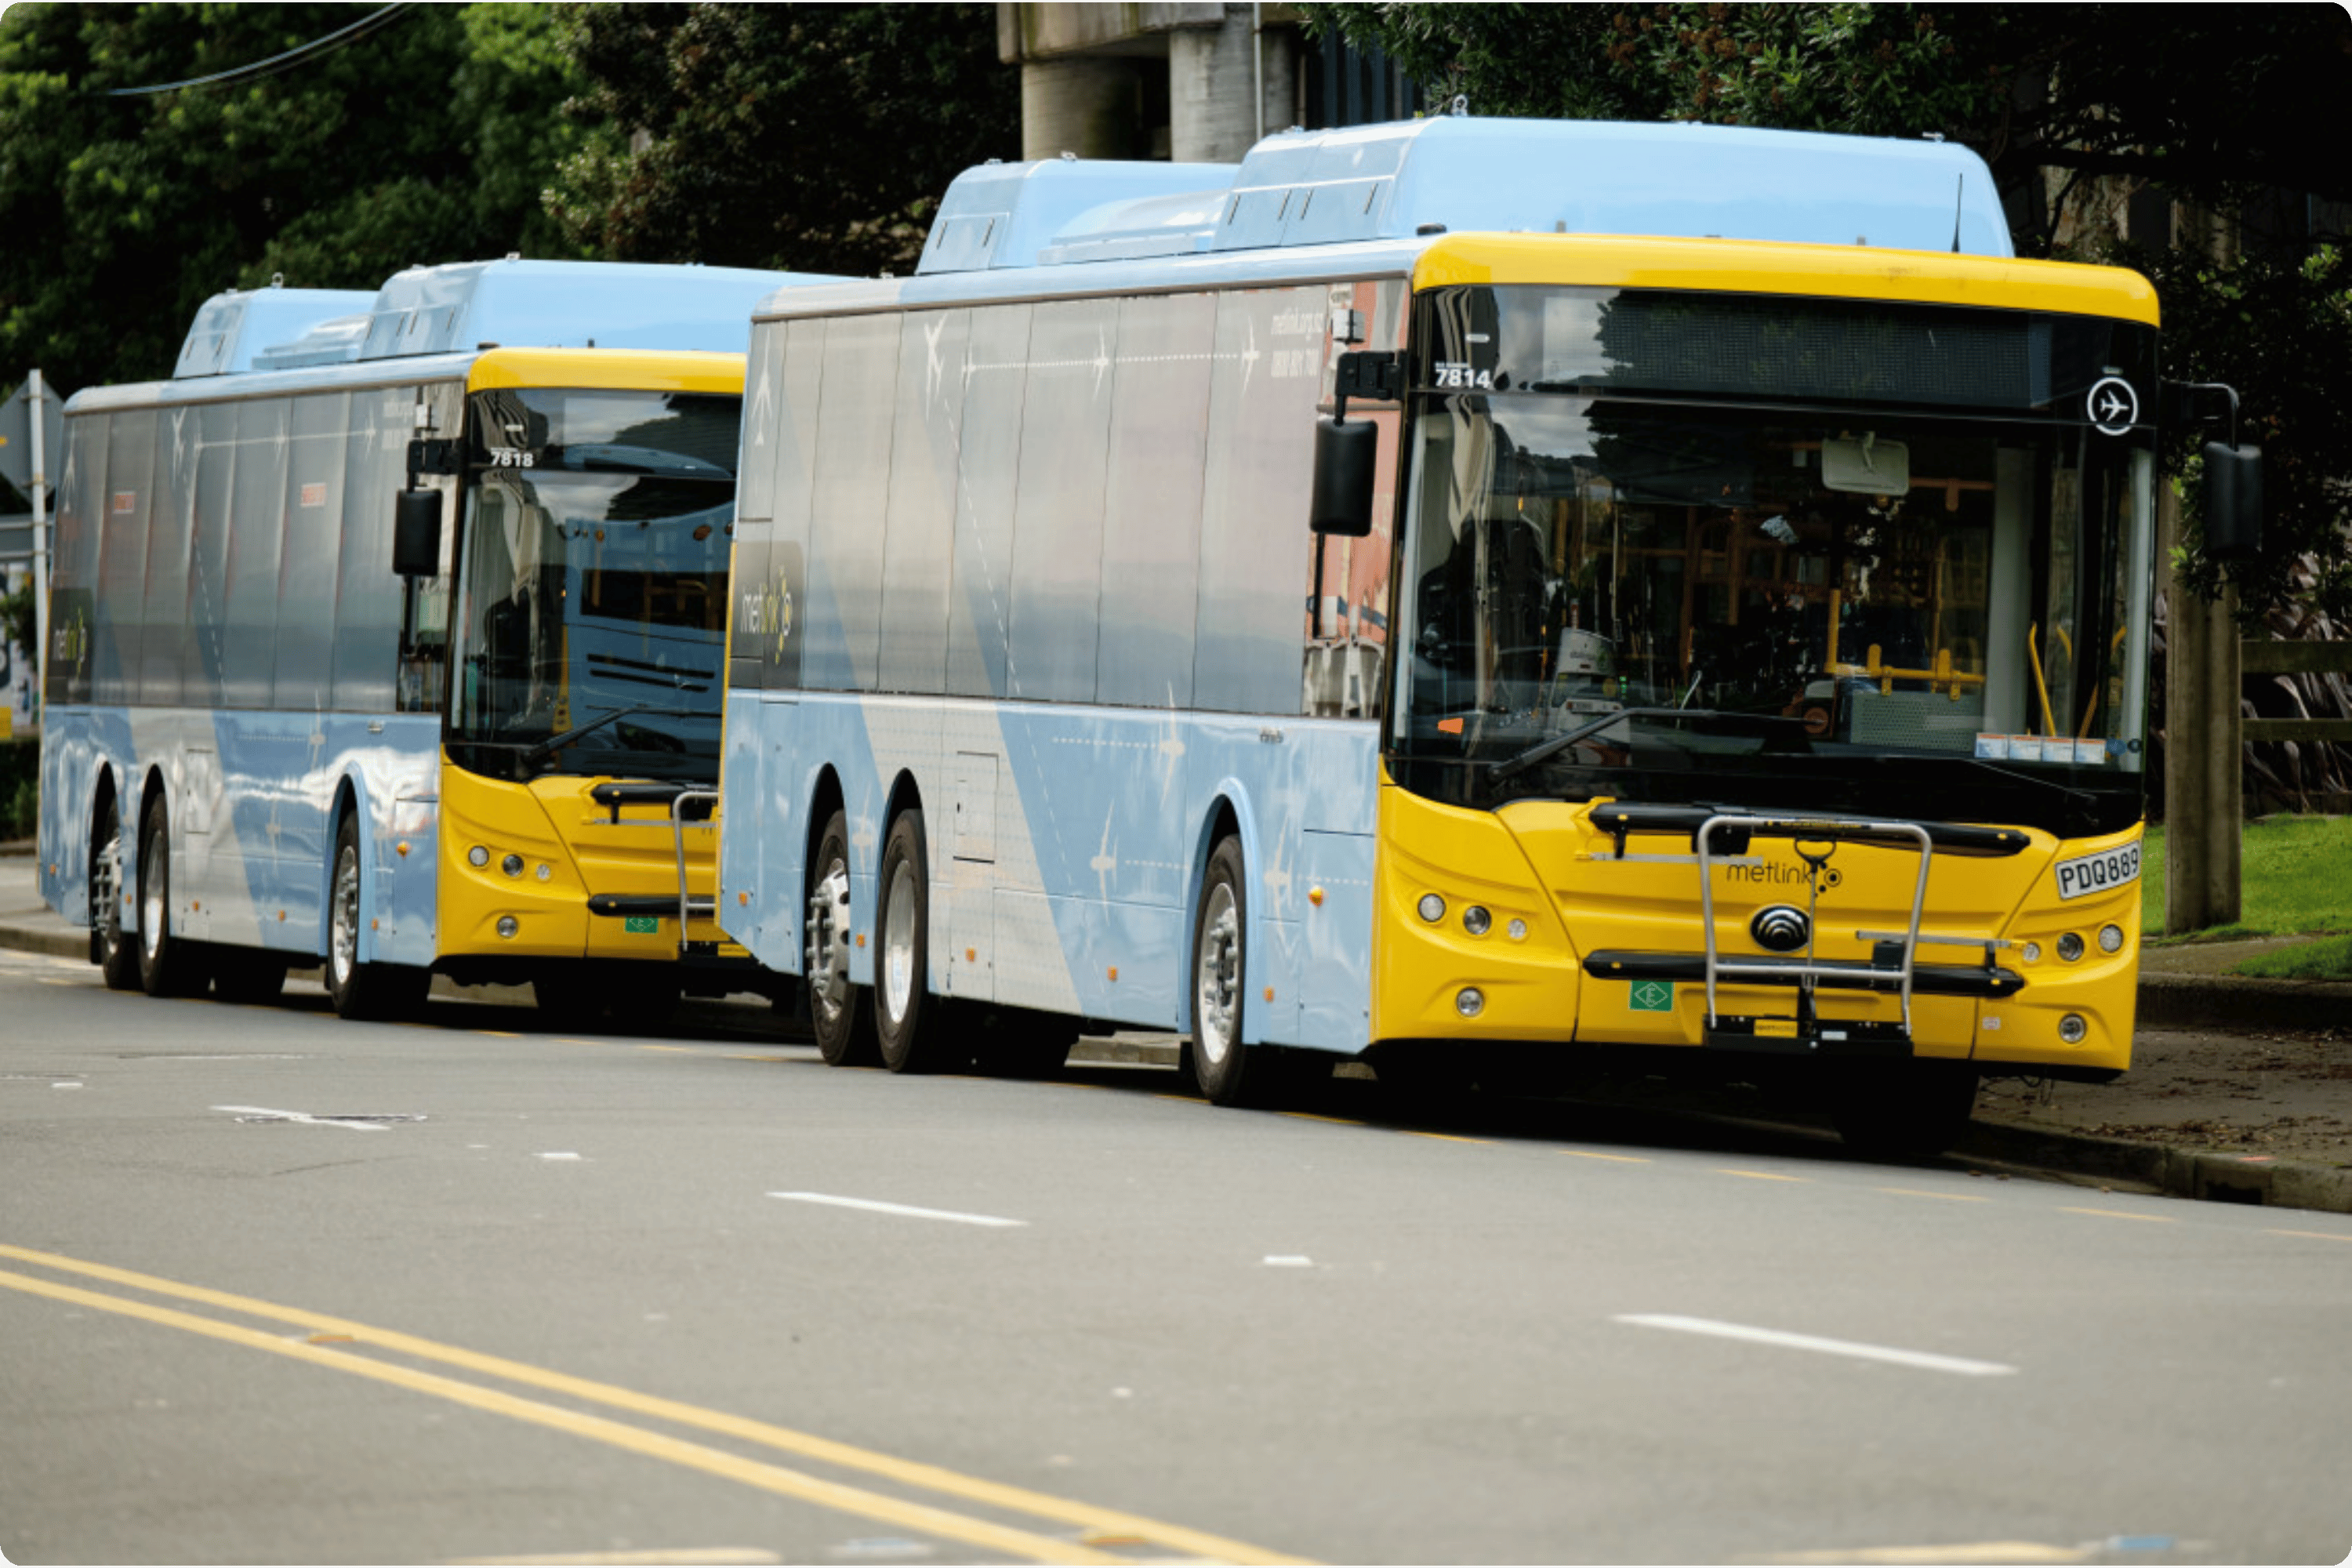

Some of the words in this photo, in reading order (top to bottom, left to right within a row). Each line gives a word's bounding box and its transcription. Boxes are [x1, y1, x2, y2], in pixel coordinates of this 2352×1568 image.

[1435, 368, 1490, 389] 7814
[491, 452, 533, 467] 7818
[1726, 861, 1812, 884] metlink
[2060, 848, 2138, 894] PDQ889
